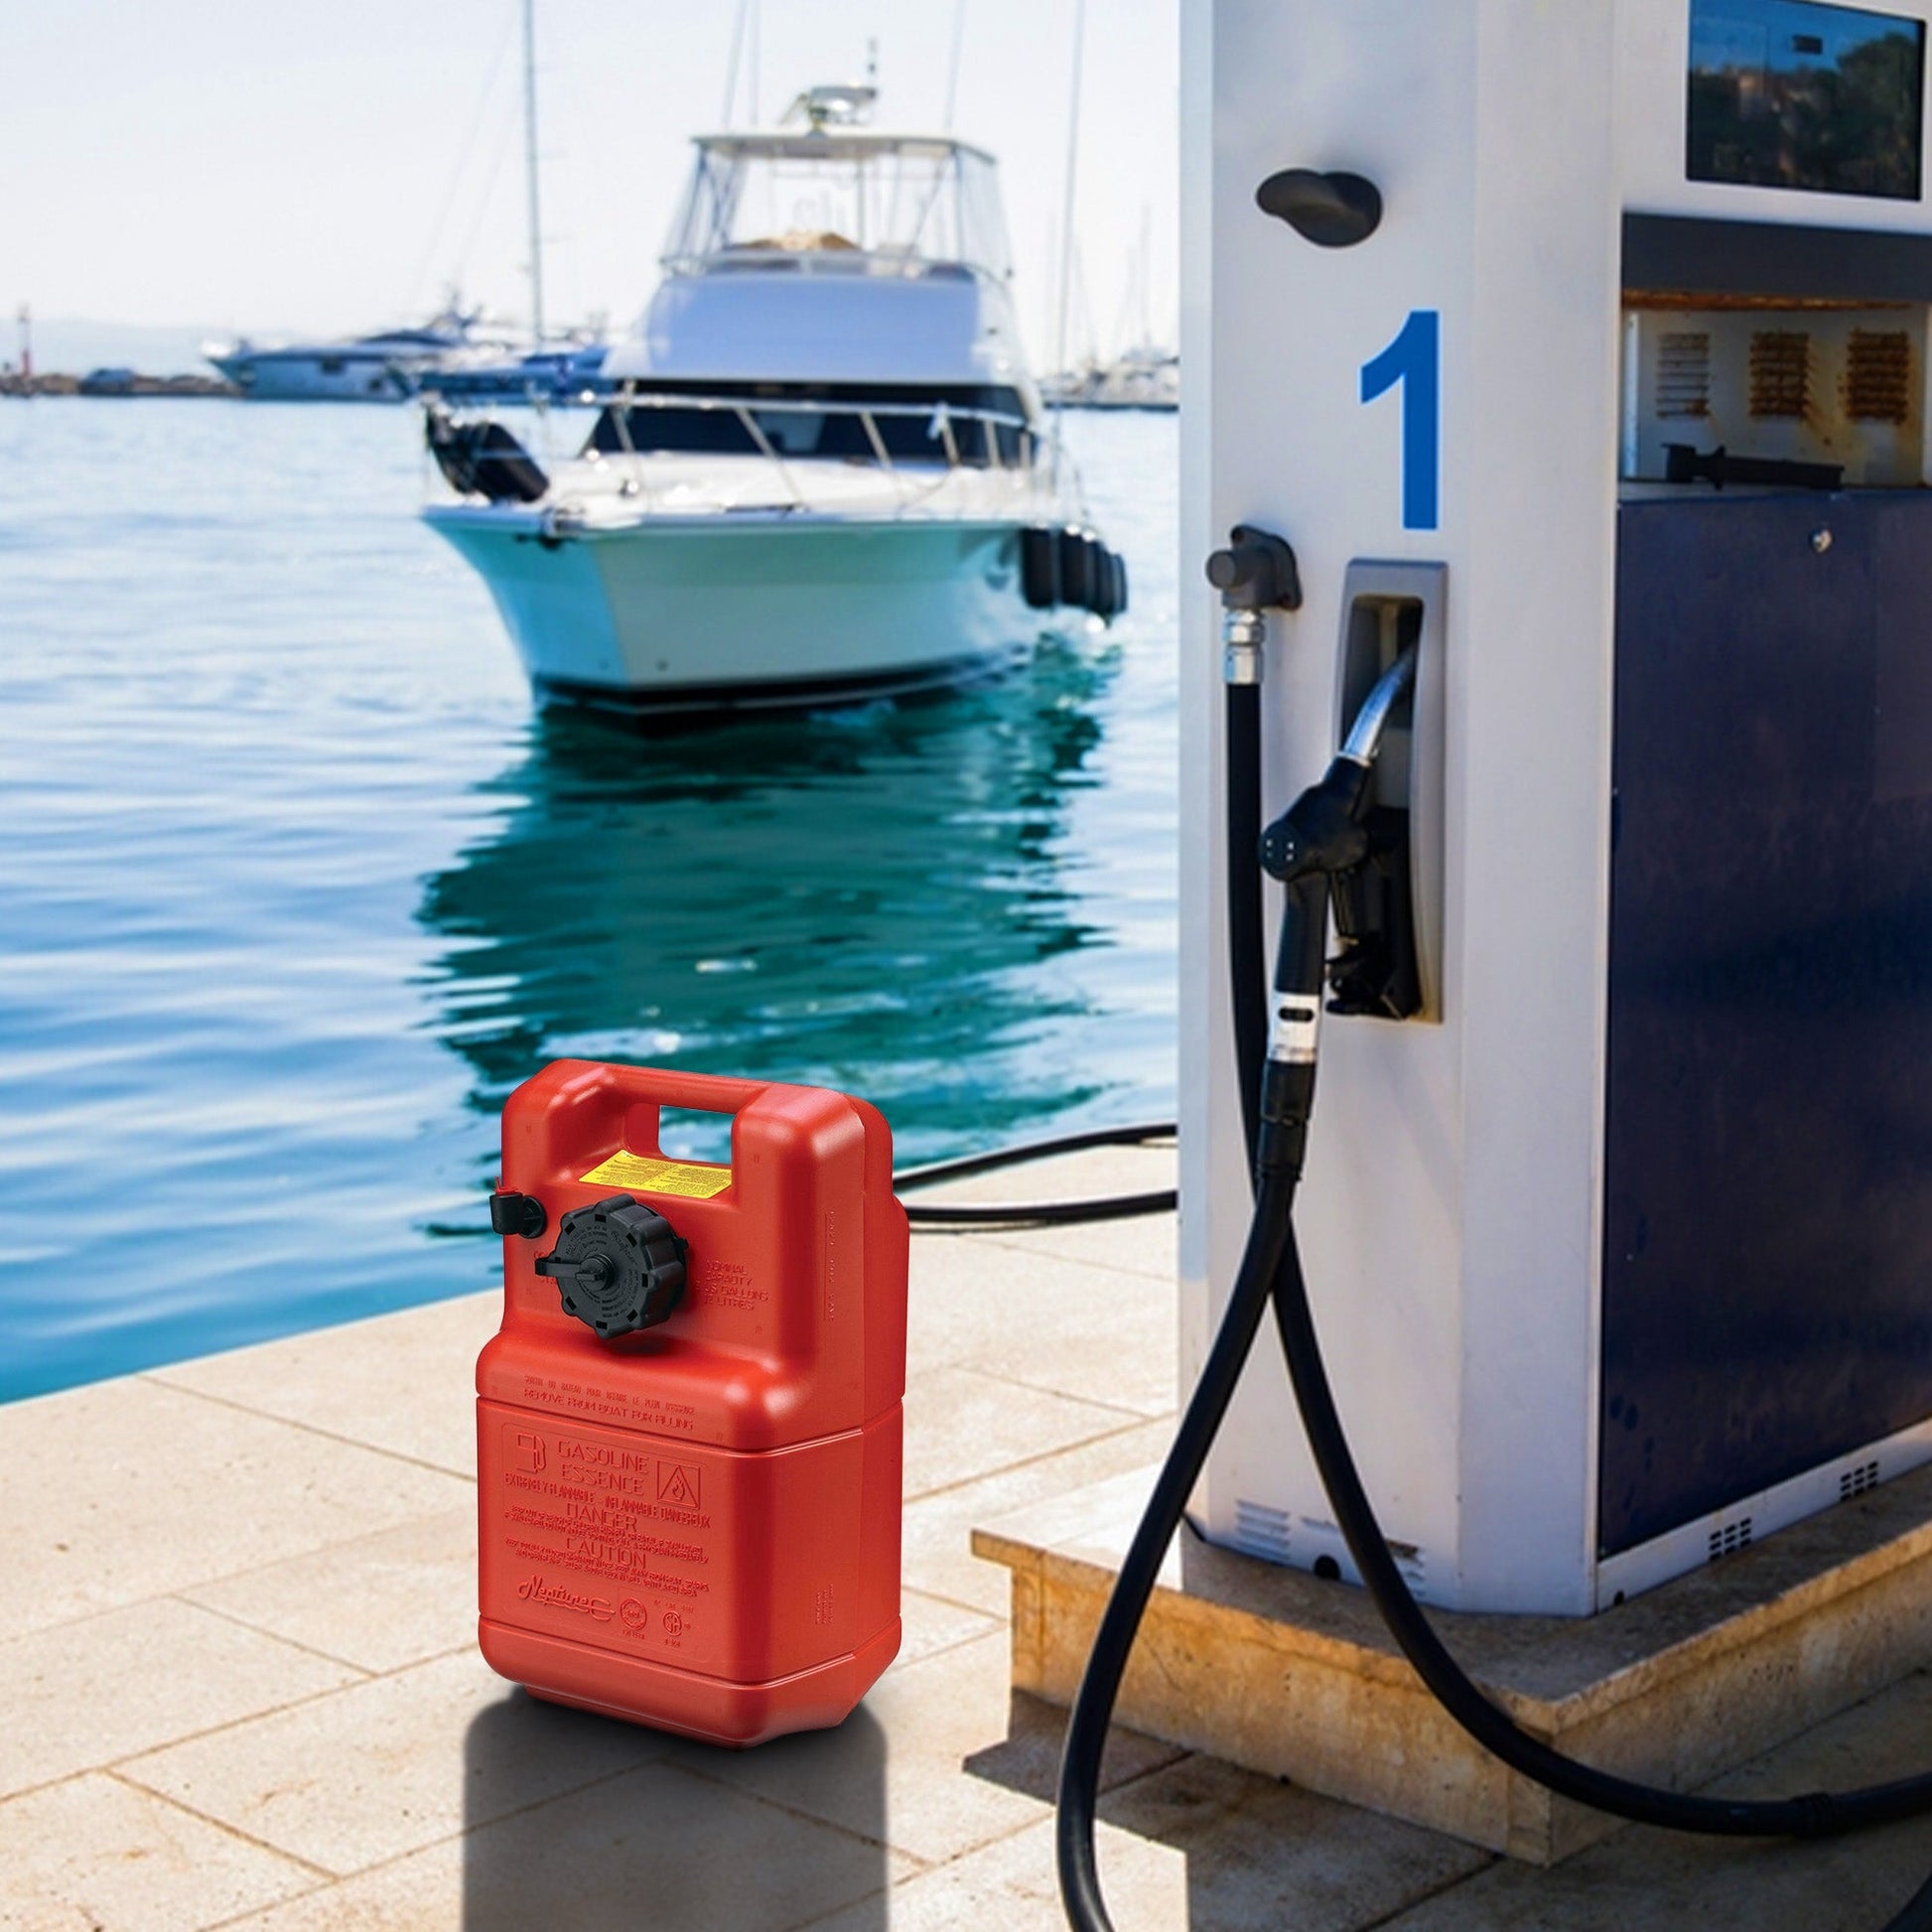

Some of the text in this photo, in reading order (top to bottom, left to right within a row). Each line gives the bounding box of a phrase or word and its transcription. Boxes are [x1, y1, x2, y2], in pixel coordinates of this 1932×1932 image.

[1360, 310, 1439, 530] 1
[717, 1296, 755, 1311] LITRES
[721, 1286, 769, 1302] GALLONS
[523, 1389, 564, 1406] REMOVE
[567, 1397, 597, 1411] FROM
[598, 1404, 627, 1418] BOAT
[631, 1409, 652, 1423] FOR
[655, 1414, 694, 1431] FILLING
[558, 1440, 650, 1474] GASOLINE
[505, 1472, 548, 1493] EXTREMELY
[562, 1462, 645, 1496] ESSENCE
[567, 1502, 637, 1532] DANGER
[566, 1538, 646, 1569] CAUTION
